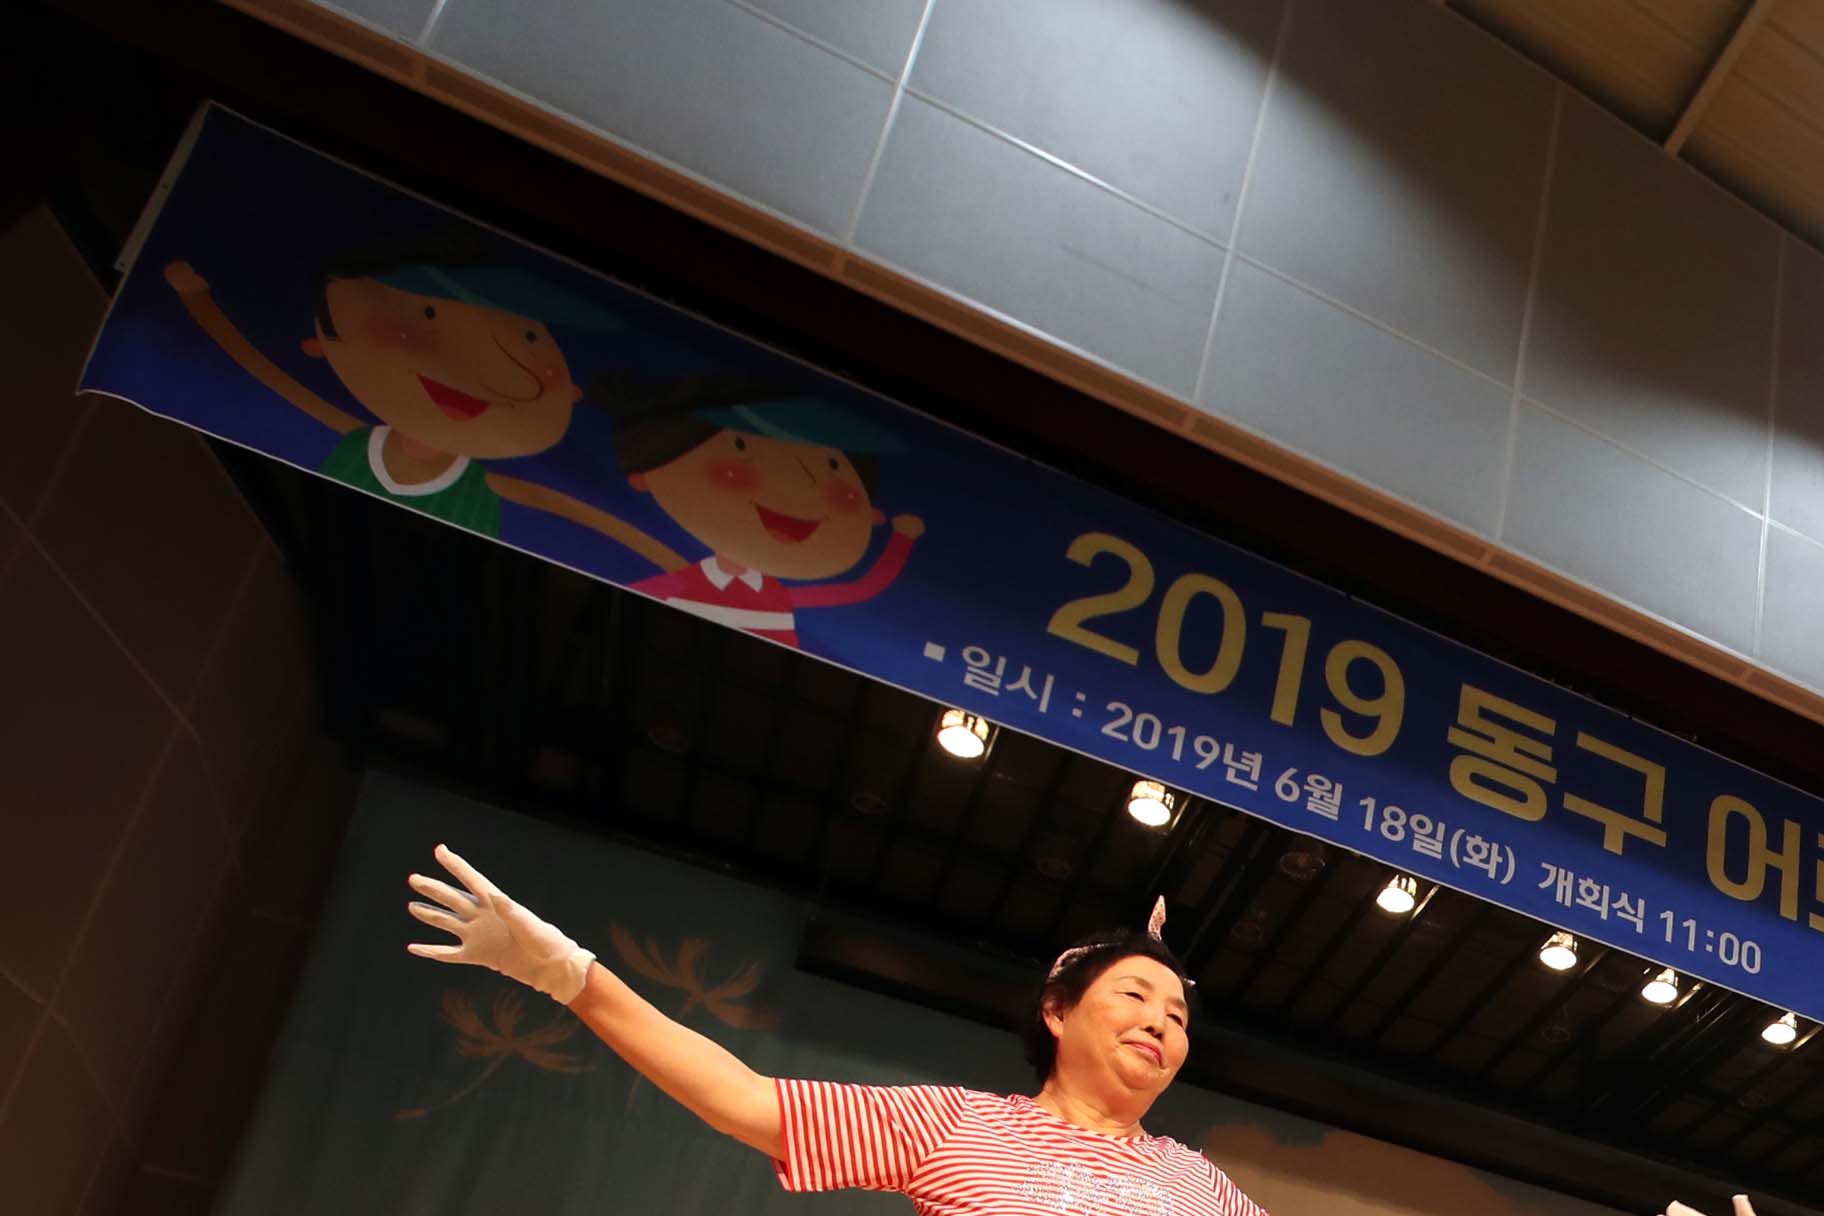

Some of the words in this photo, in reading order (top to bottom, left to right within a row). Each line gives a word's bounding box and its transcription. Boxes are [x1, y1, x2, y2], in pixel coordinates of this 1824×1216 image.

[961, 646, 1055, 713] 일시
[1101, 702, 1262, 791] 2019년
[1274, 768, 1343, 821] 6월
[1359, 796, 1516, 884] 18일(화)
[1538, 862, 1645, 934] 개회식
[1659, 911, 1762, 975] 11:00
[1047, 531, 1405, 756] 2019
[1448, 683, 1667, 856] 동구
